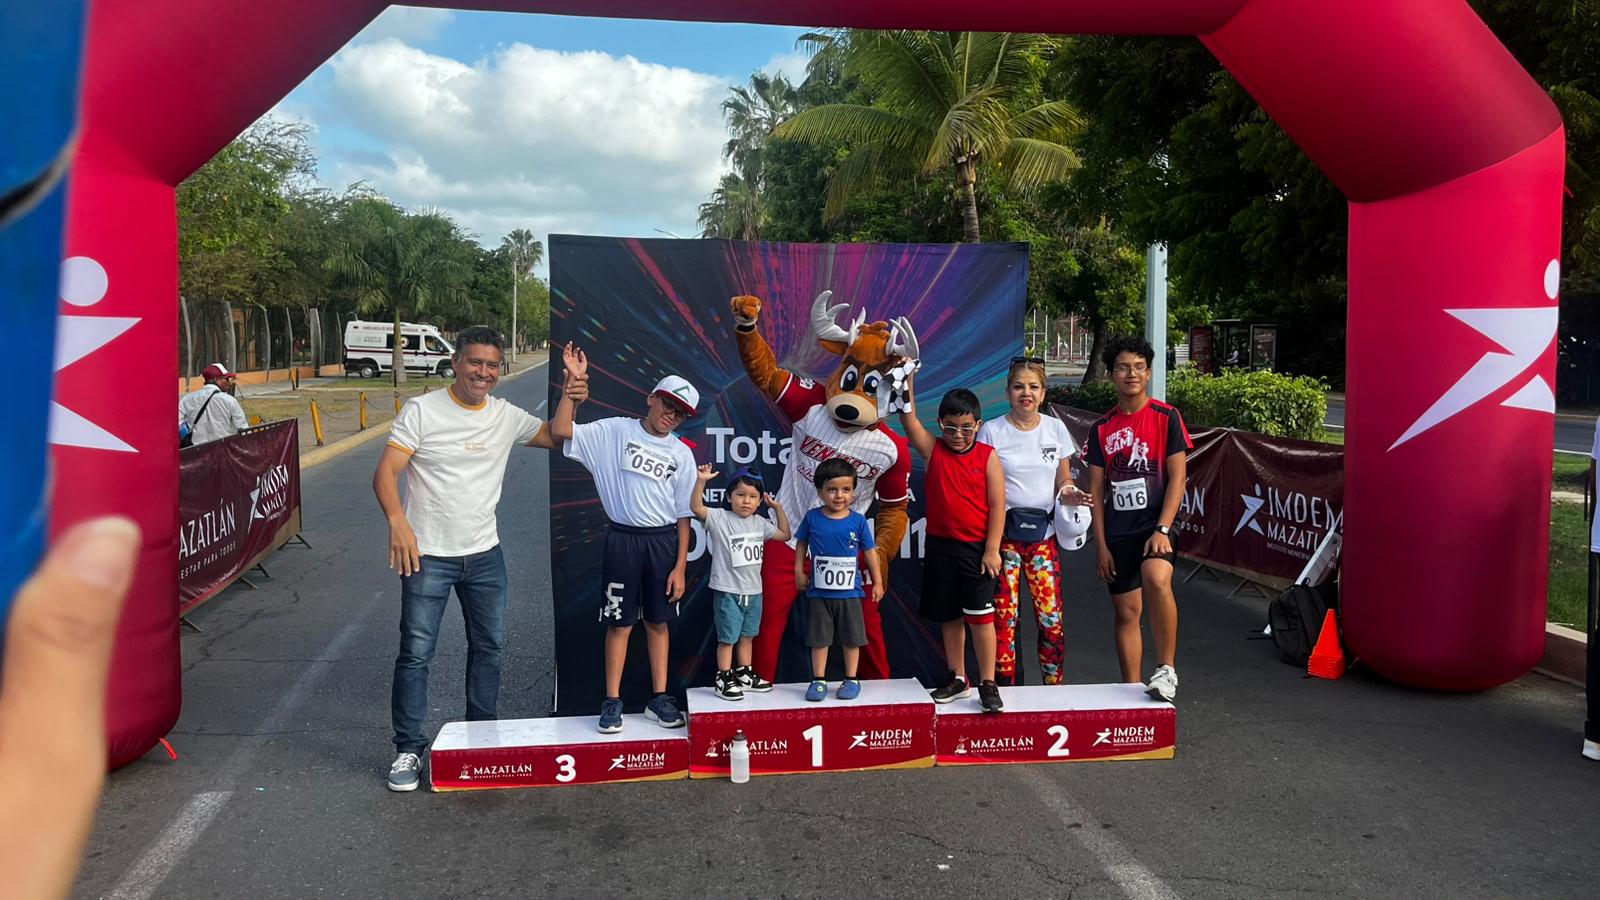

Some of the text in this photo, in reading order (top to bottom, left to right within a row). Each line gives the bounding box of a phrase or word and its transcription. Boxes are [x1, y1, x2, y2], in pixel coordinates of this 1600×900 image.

[706, 427, 793, 465] Tota
[632, 454, 665, 477] 056
[1116, 491, 1146, 507] 016
[1268, 486, 1343, 534] IMDEM
[179, 498, 236, 560] AZATLÁN
[824, 570, 855, 586] 007
[870, 729, 913, 740] IMDEM
[1113, 726, 1155, 737] IMDEM
[722, 738, 788, 752] MATLÁN
[802, 725, 823, 767] 1
[970, 735, 1034, 749] MAZATLÁN
[1047, 725, 1070, 757] 2
[627, 752, 665, 762] IMDEM
[473, 763, 532, 775] MAZATLÁN
[555, 754, 577, 783] 3
